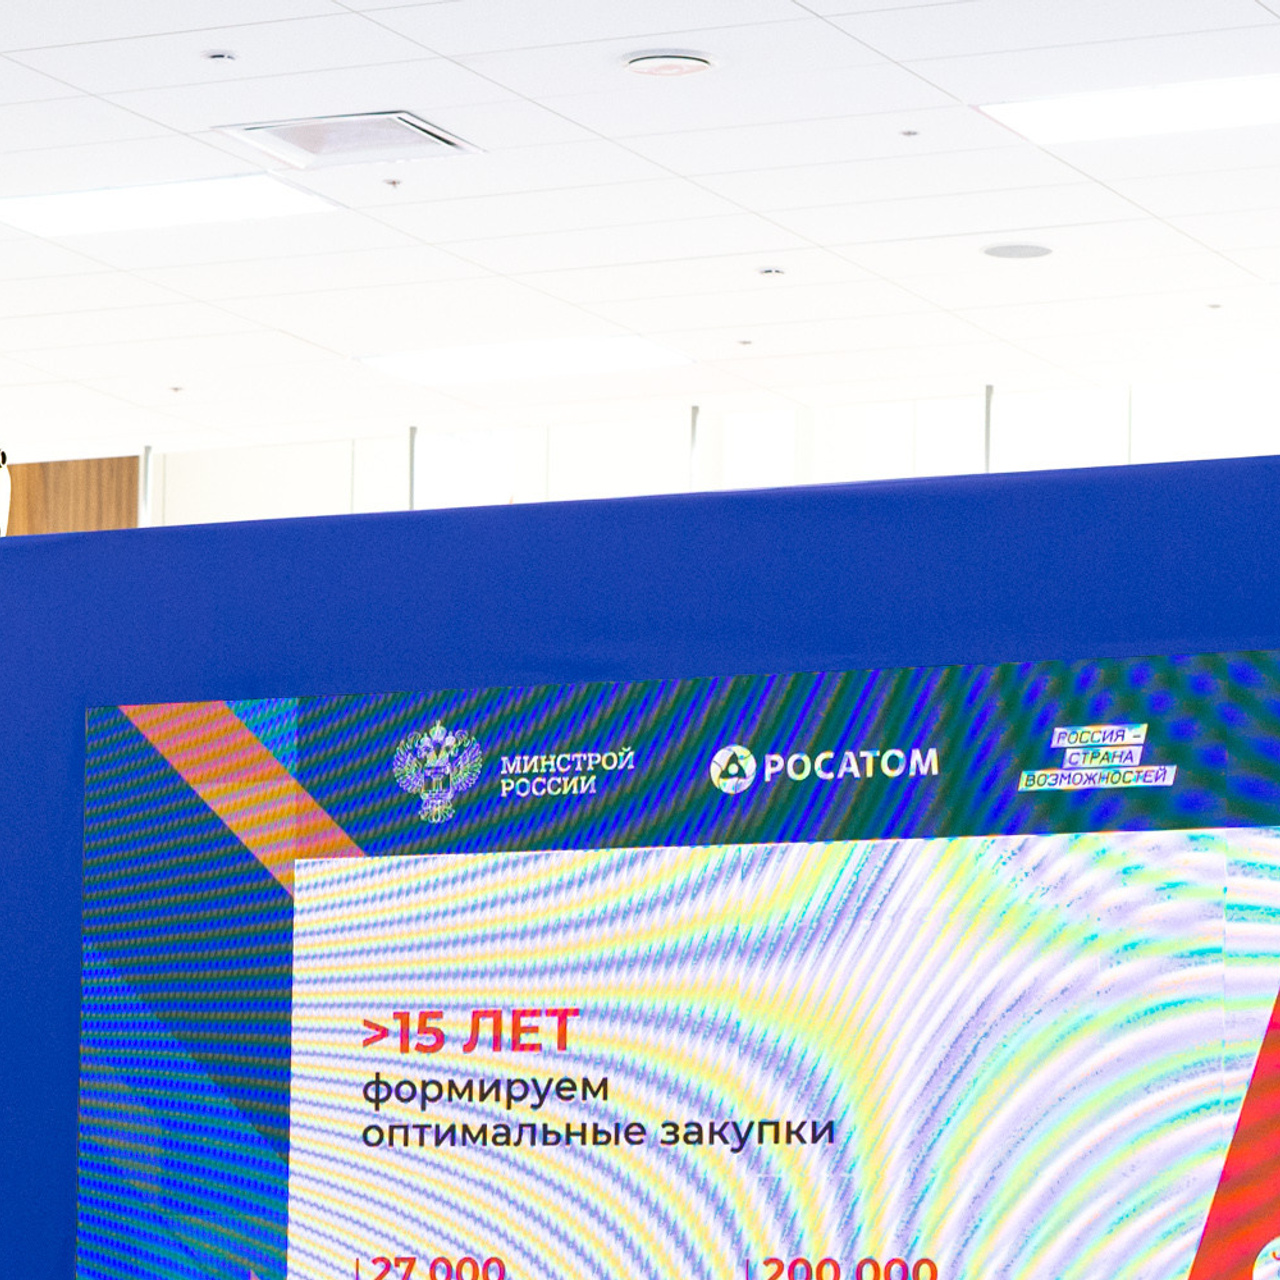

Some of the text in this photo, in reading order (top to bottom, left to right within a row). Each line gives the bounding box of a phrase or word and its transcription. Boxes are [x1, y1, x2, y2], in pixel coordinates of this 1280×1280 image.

[1056, 729, 1126, 745] РОССИЯ
[500, 746, 635, 775] МИНСТРОЙ
[764, 747, 939, 783] РОСАТОМ
[1068, 750, 1135, 766] СТРАНА
[500, 774, 597, 798] РОССИИ
[1024, 766, 1168, 787] ВОЗМОЖНОСТЕЙ
[362, 1007, 580, 1055] >15 ЛЕТ
[361, 1072, 609, 1110] формируем
[361, 1117, 836, 1154] оптимальные закупки
